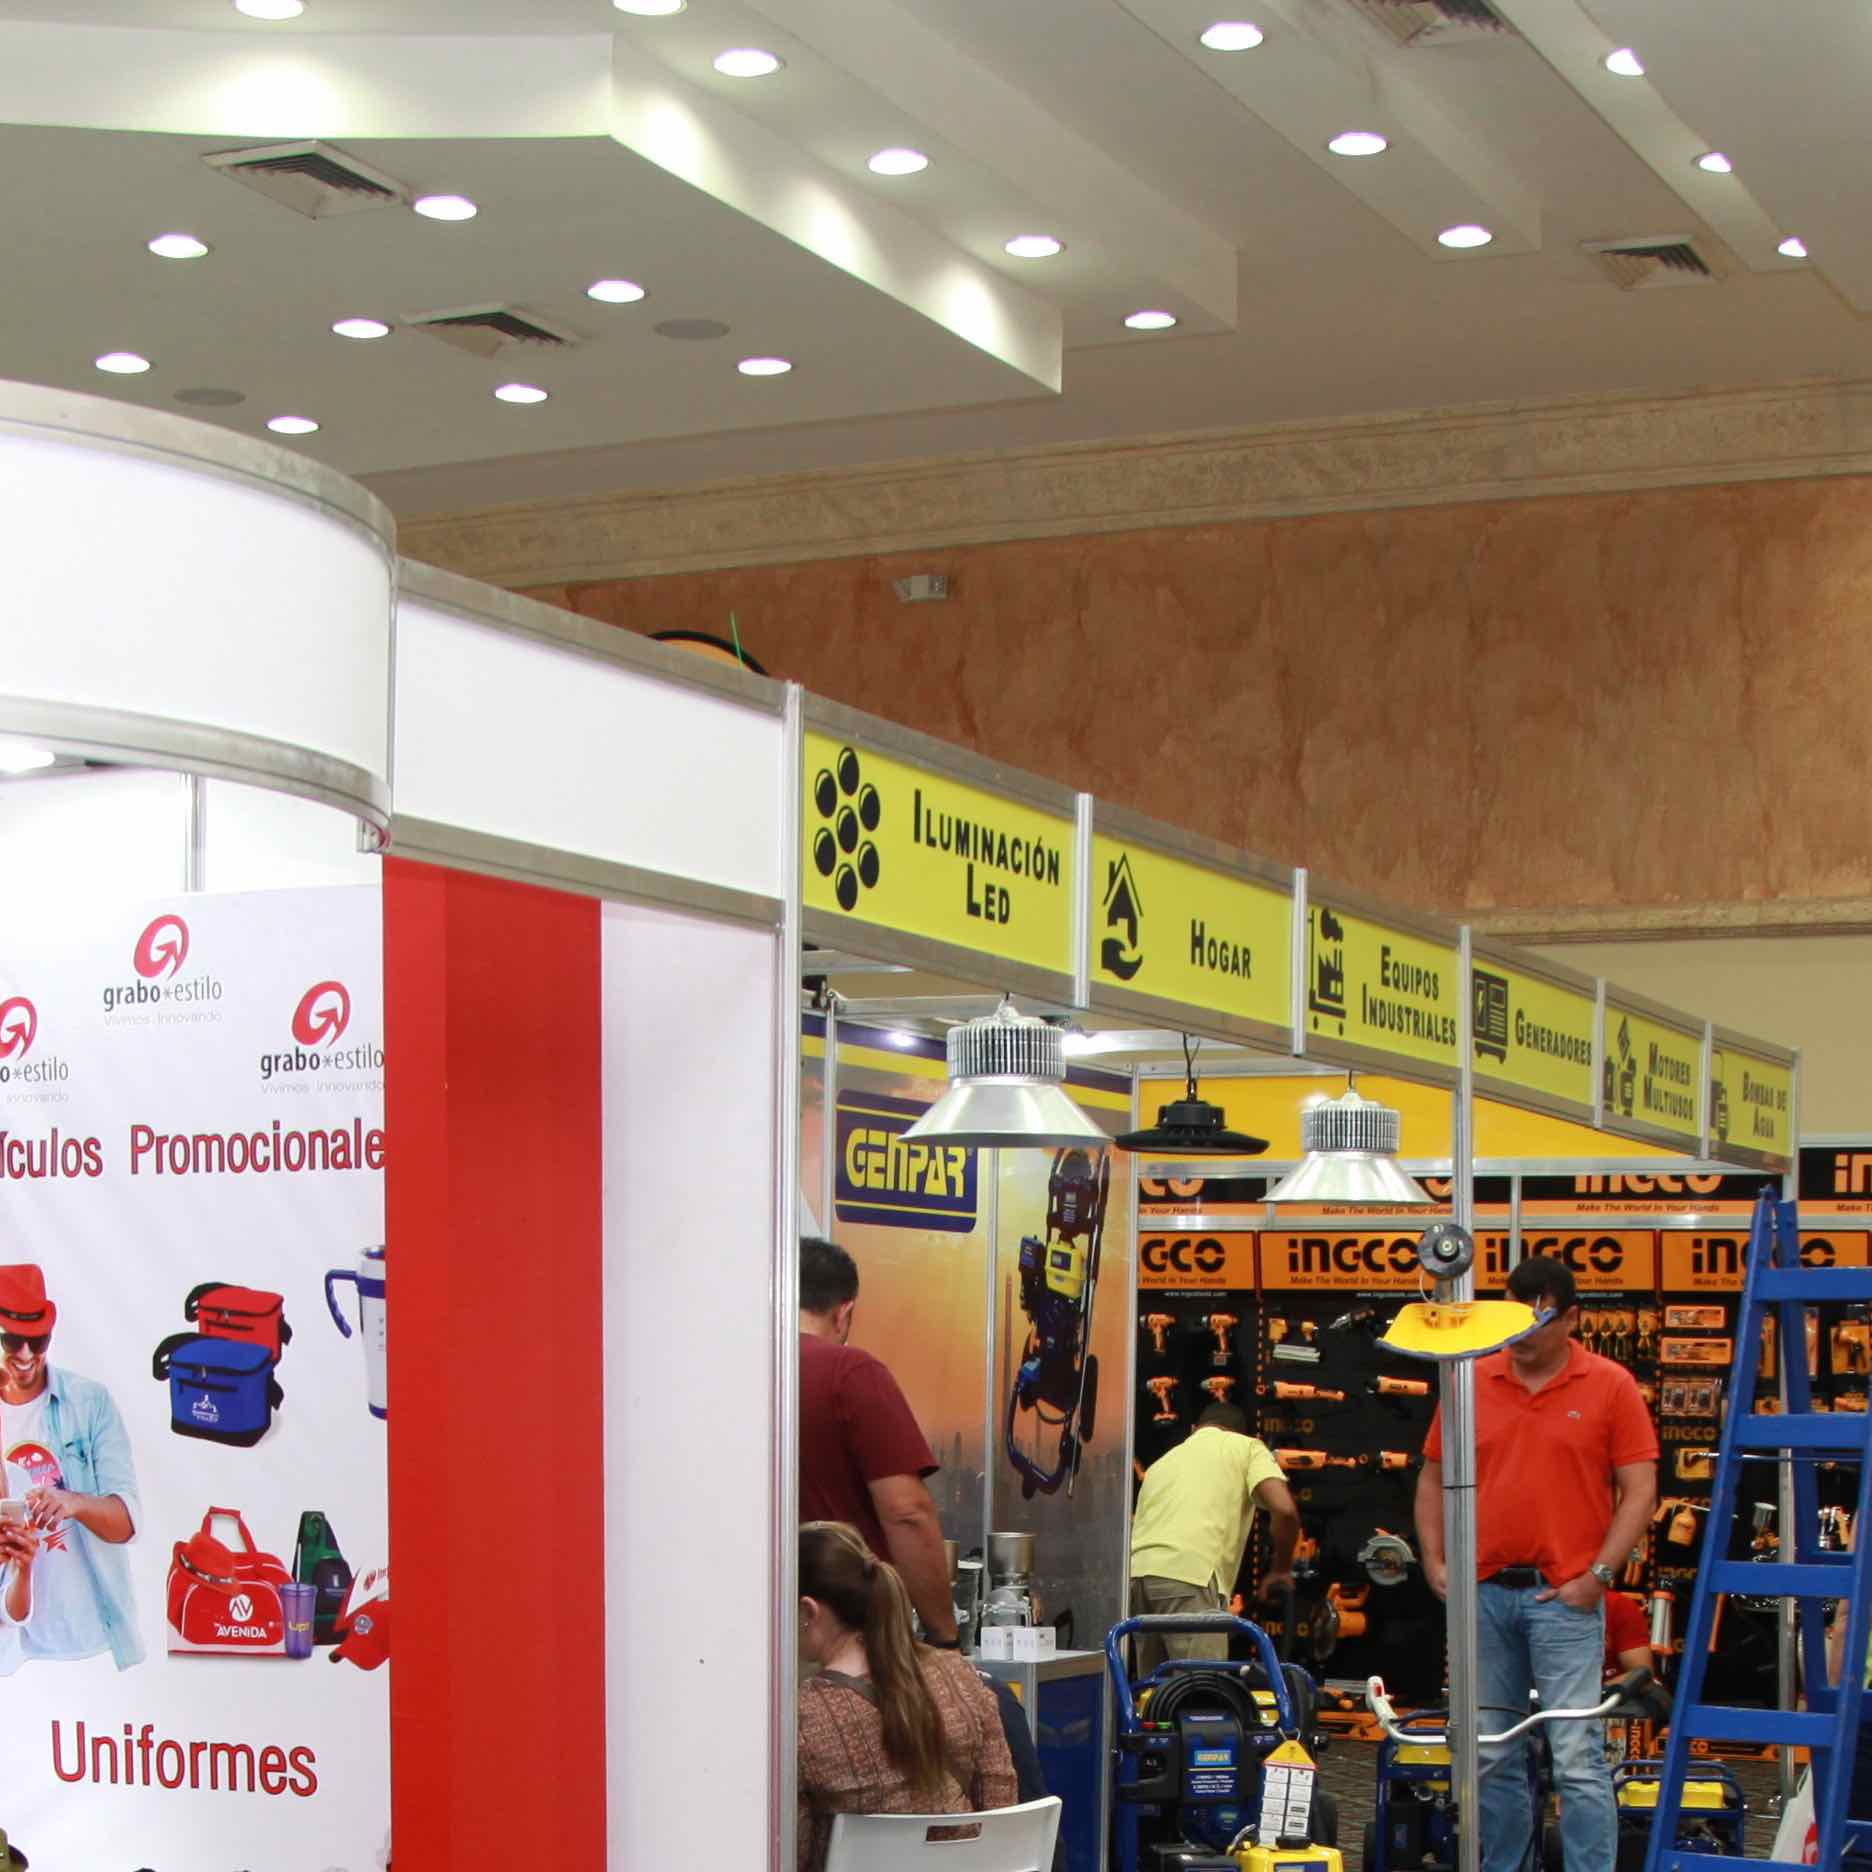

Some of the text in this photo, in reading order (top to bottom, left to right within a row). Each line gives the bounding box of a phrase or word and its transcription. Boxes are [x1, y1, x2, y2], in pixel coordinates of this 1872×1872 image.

[131, 1118, 385, 1175] Promocionale
[216, 1625, 267, 1639] AVENIDA
[51, 1720, 318, 1797] Uniformes
